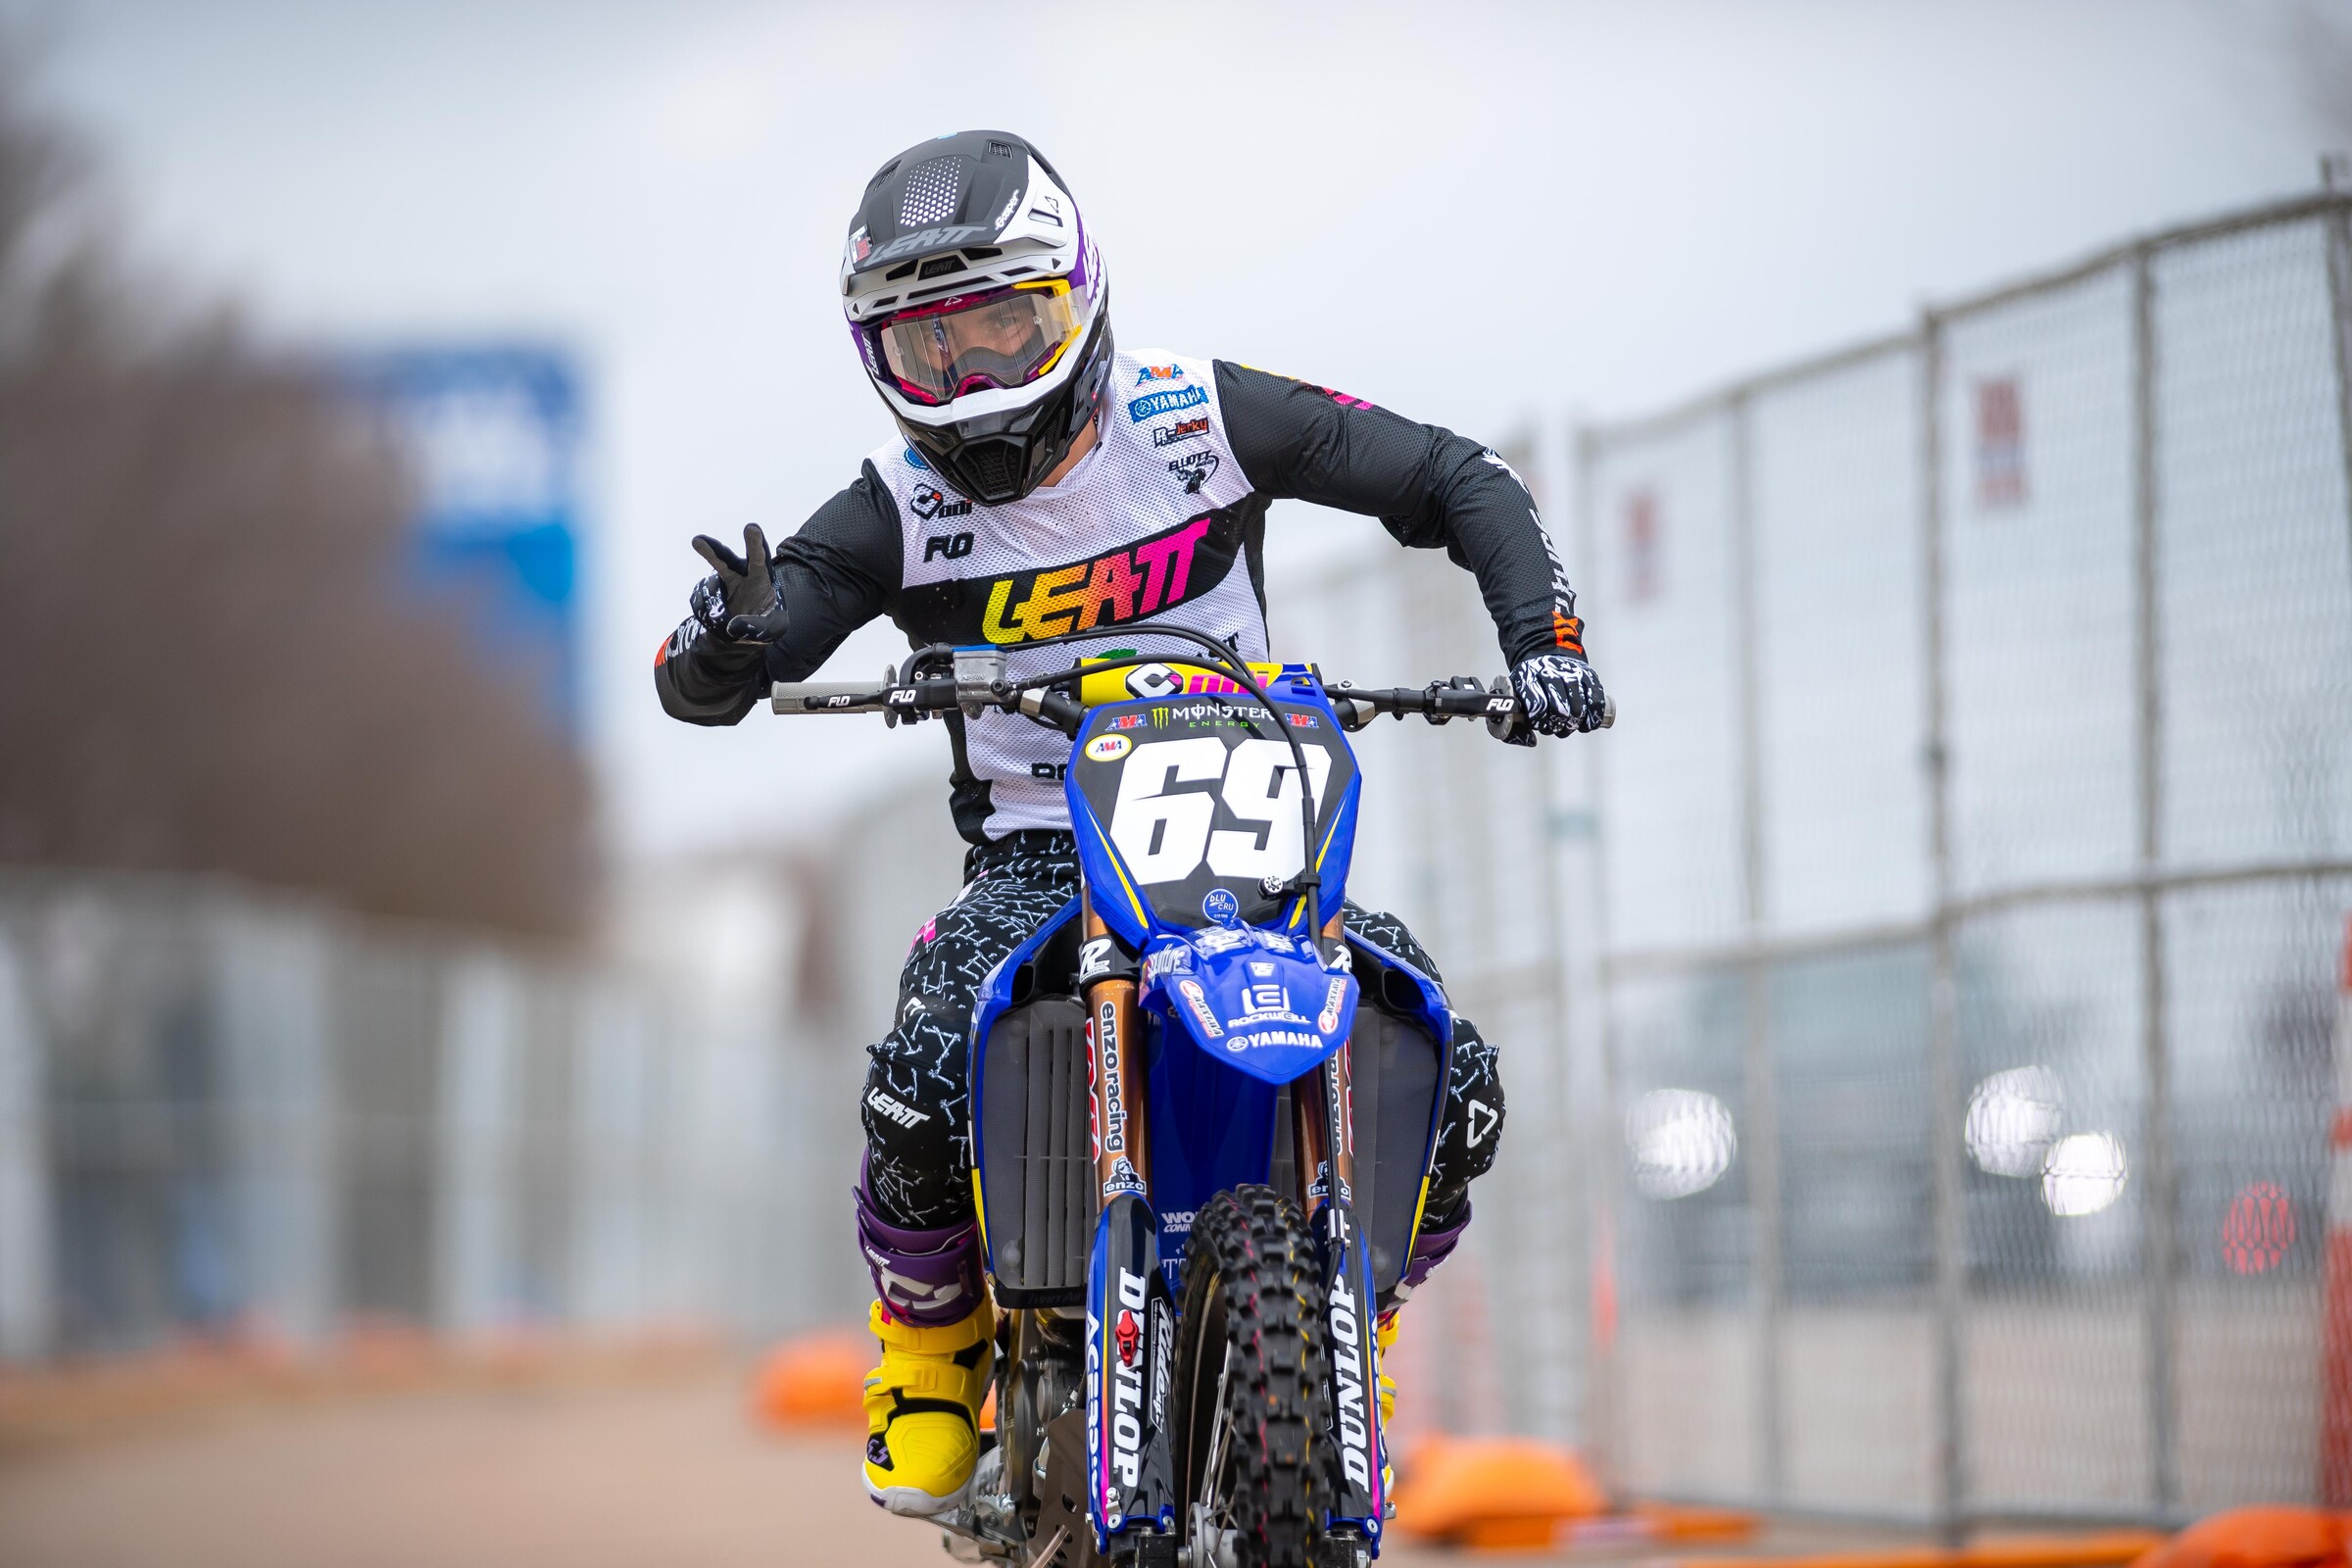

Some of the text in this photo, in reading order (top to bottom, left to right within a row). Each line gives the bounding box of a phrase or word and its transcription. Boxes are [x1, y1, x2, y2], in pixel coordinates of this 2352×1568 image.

[862, 226, 988, 268] LEATT
[924, 259, 956, 275] LEATT
[861, 332, 880, 374] LEATT
[1135, 364, 1185, 388] AMA
[1150, 388, 1203, 412] YAMAHA
[1168, 450, 1212, 470] ELLIOTT
[923, 531, 975, 564] FLO
[981, 516, 1211, 645] LEATT
[827, 695, 852, 709] FLO
[889, 689, 917, 704] FLO
[1486, 698, 1515, 711] FLO
[1172, 703, 1275, 721] MONSTER
[1104, 713, 1149, 731] AMA
[1189, 719, 1261, 729] ENERGY
[1095, 740, 1123, 754] AMA
[1109, 736, 1333, 885] 69
[1228, 1010, 1311, 1028] ROCKWELL
[1248, 1031, 1324, 1049] YAMAHA
[867, 1086, 931, 1129] LEATT
[1105, 1180, 1144, 1192] enzo
[1330, 1273, 1369, 1493] DUNLOP
